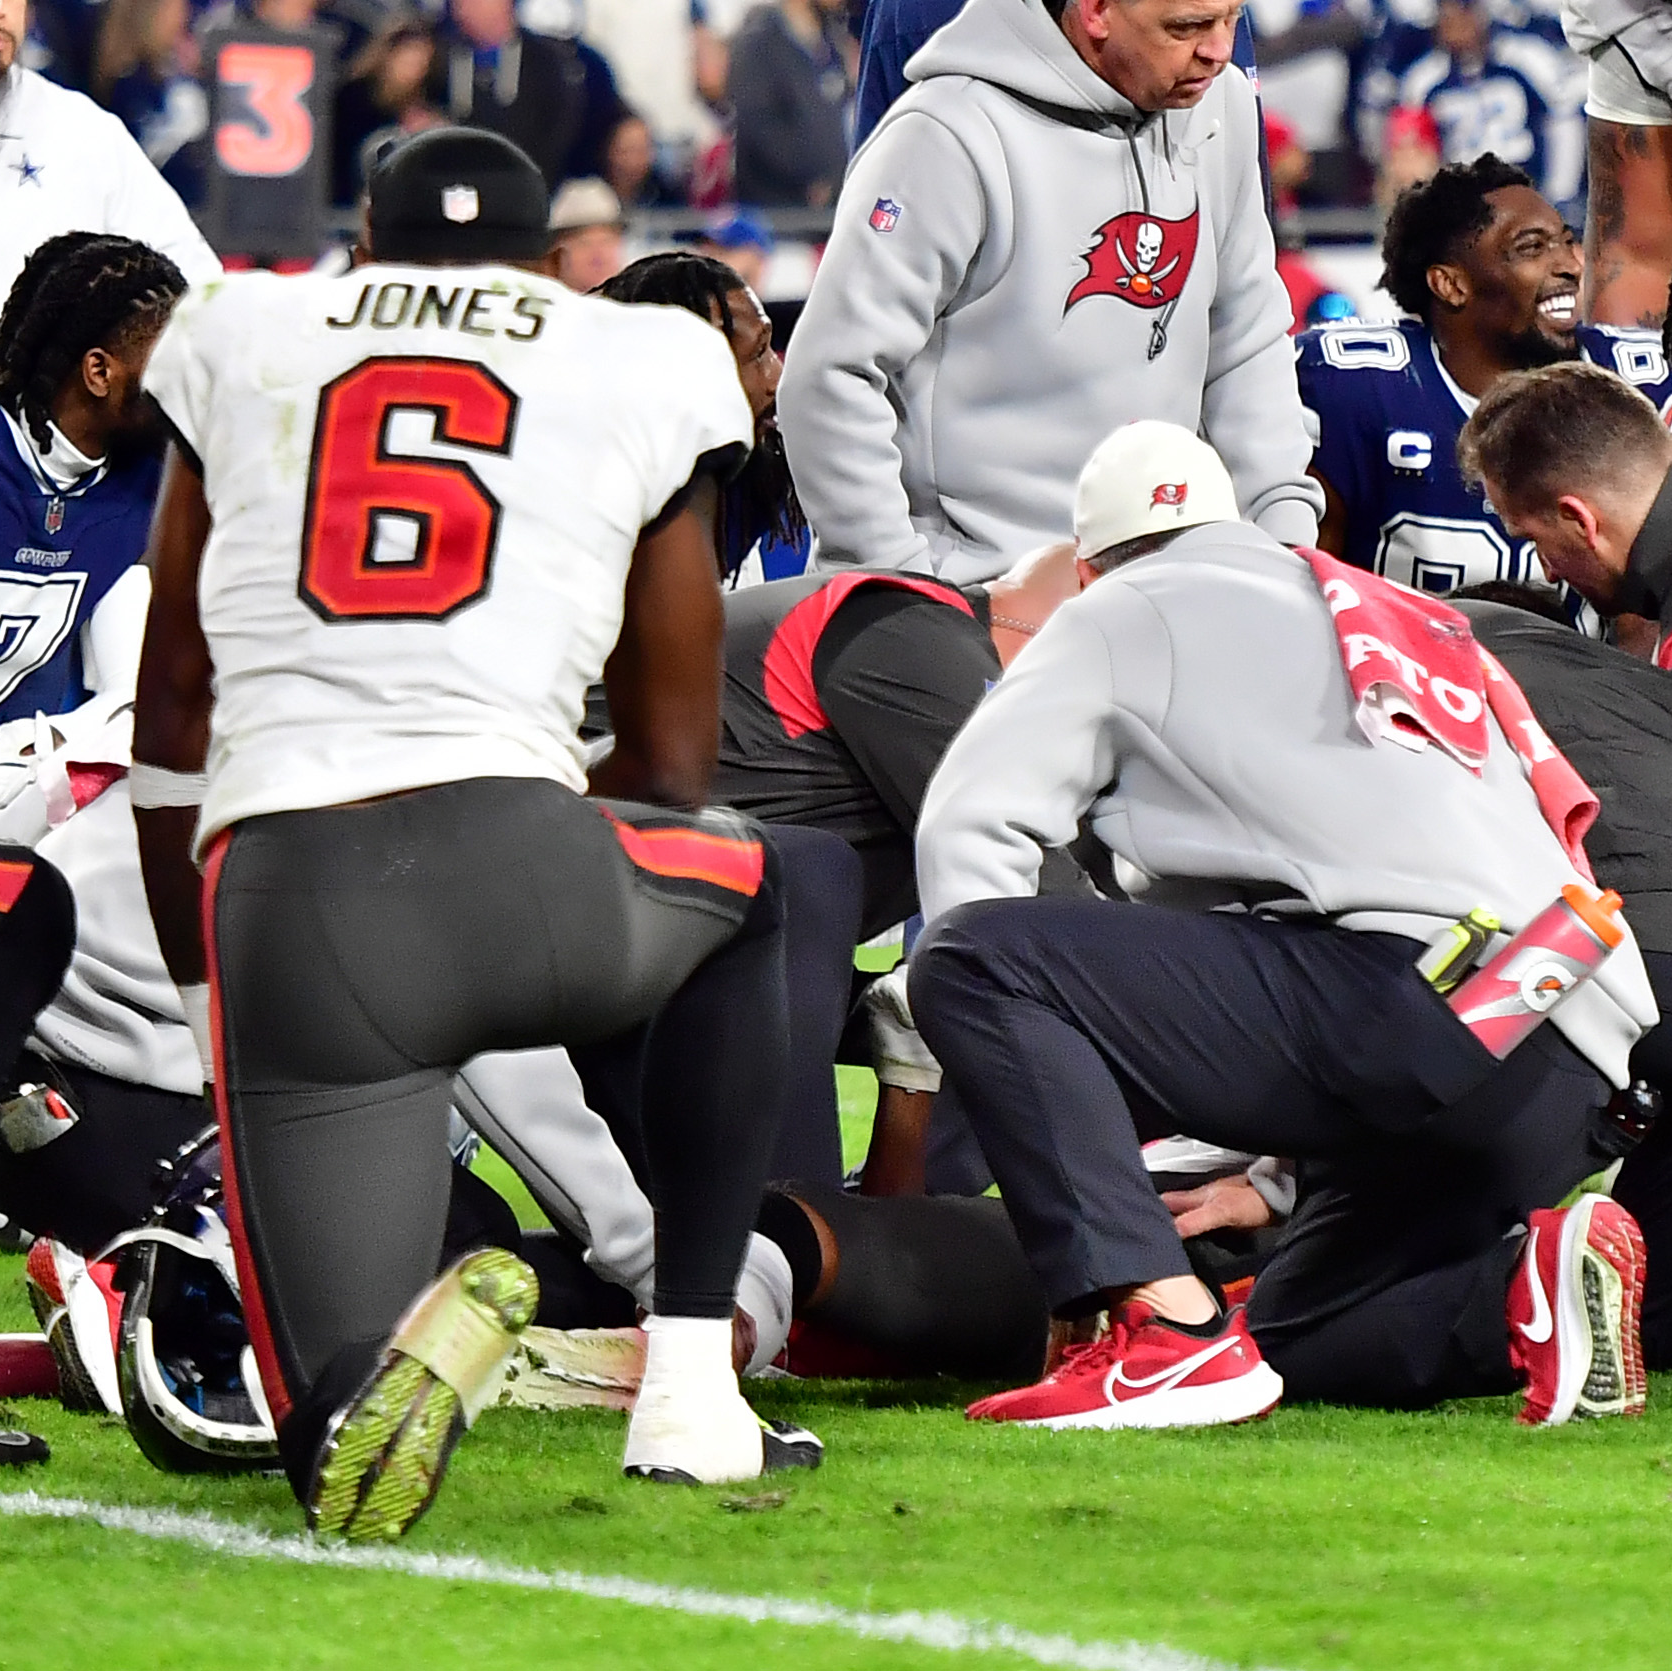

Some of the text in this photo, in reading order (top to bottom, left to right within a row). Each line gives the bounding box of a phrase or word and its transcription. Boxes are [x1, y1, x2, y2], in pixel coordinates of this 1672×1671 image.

[217, 43, 314, 177] 3
[327, 281, 553, 341] JONES
[298, 355, 522, 626] 6
[1386, 431, 1432, 470] C
